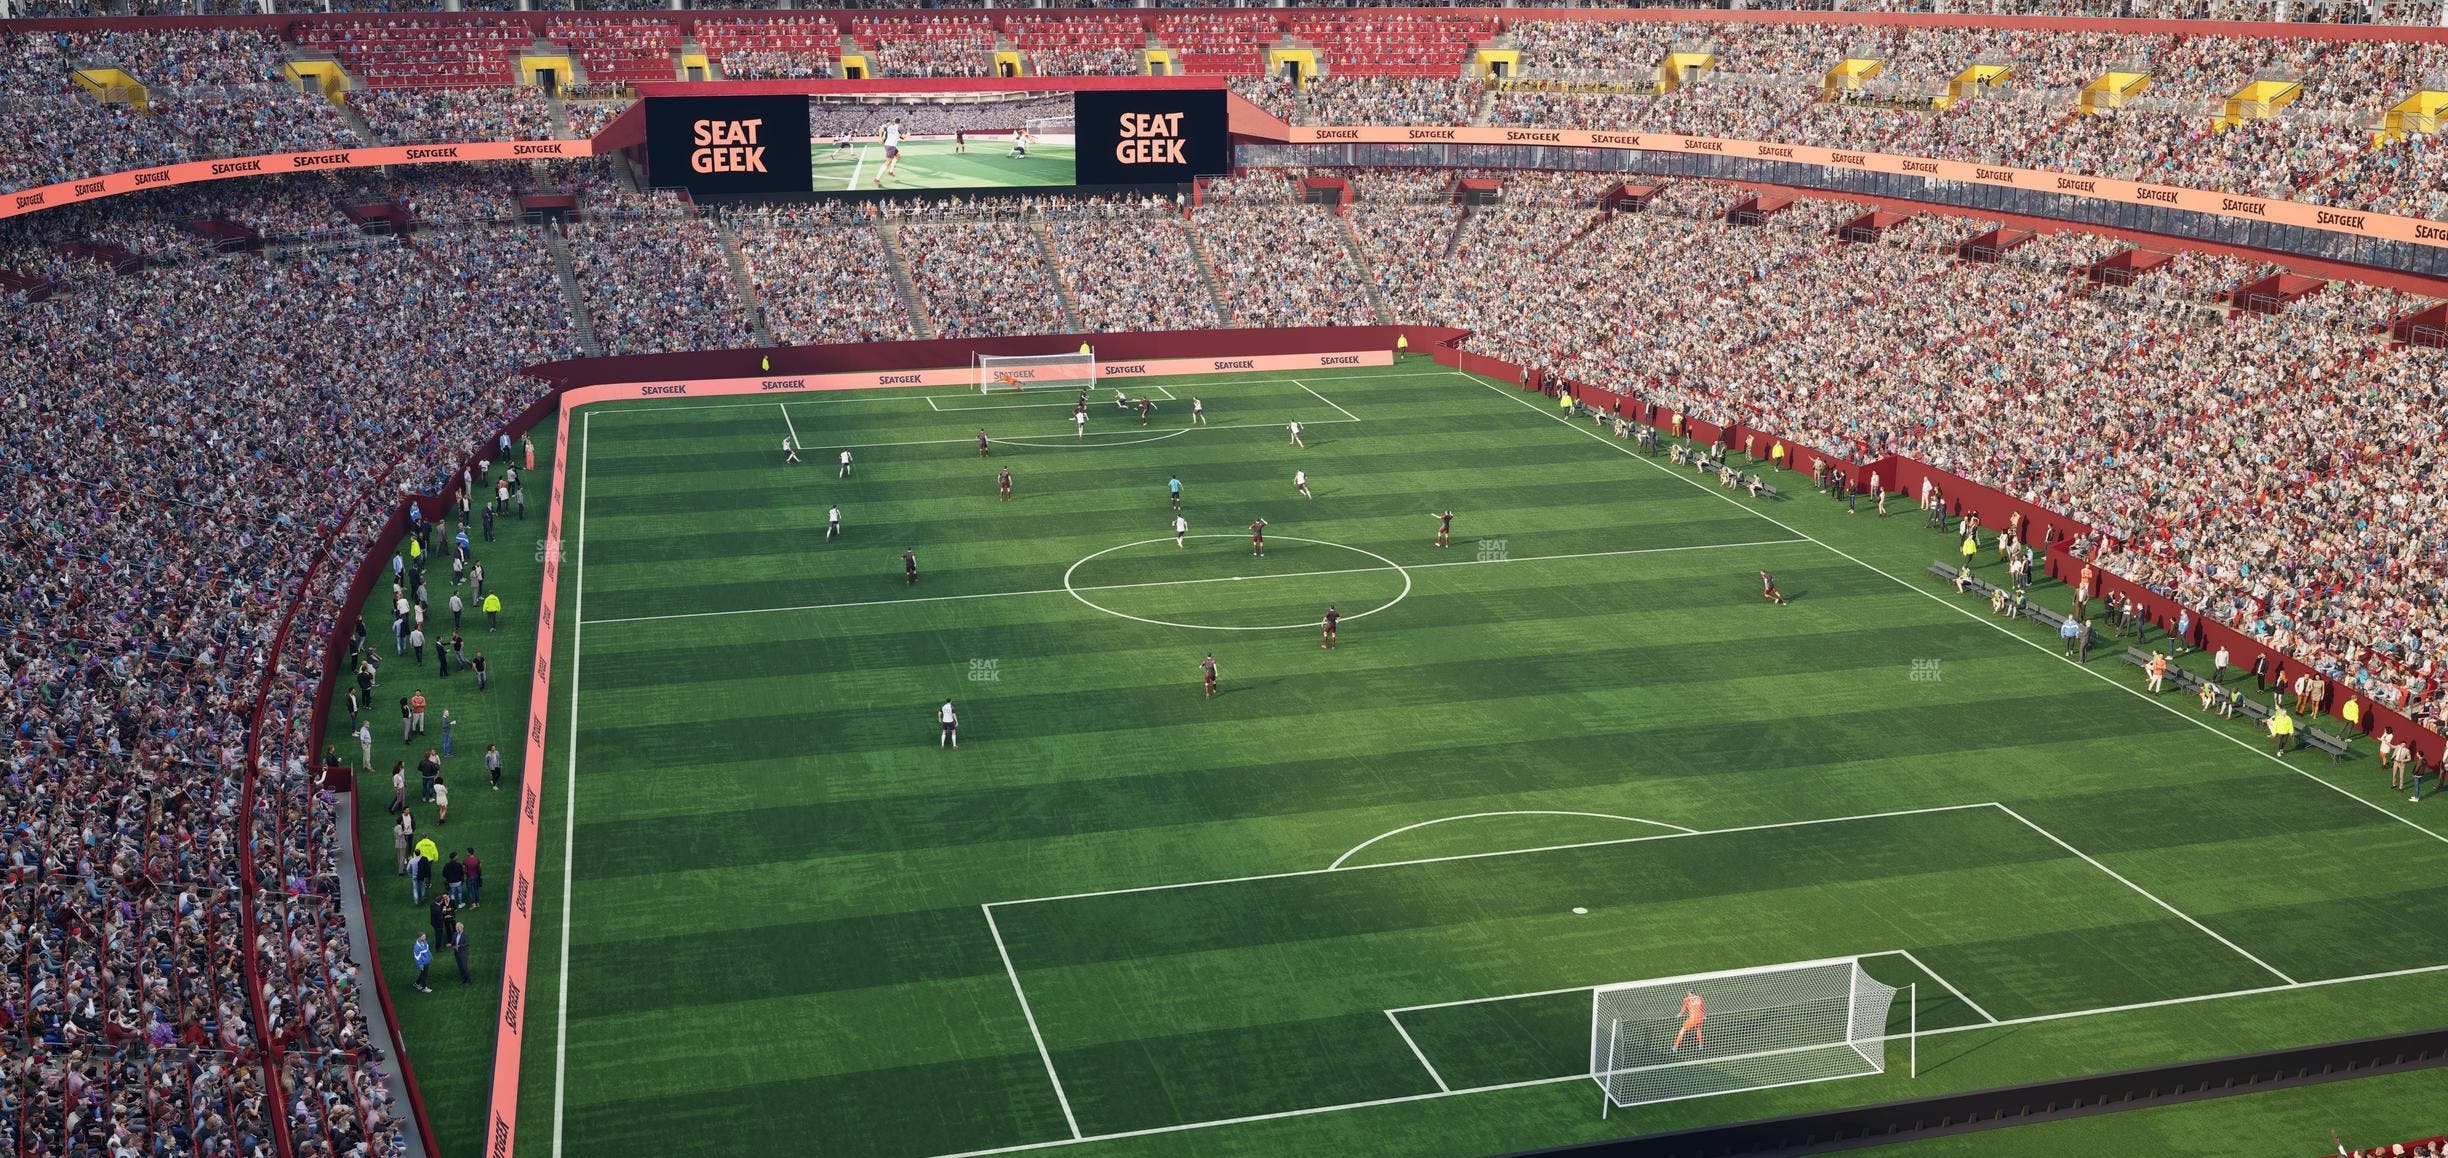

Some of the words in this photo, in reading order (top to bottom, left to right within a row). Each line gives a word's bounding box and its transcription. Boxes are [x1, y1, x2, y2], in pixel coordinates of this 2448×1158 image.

[1120, 112, 1184, 137] SEAT
[694, 119, 762, 146] SEAT
[1316, 129, 1358, 140] SEATGEEK
[1409, 129, 1454, 140] SEATGEEK
[1507, 131, 1560, 142] SEATGEEK
[1591, 134, 1640, 145] SEATGEEK
[513, 143, 562, 155] SEATGEEK
[1116, 139, 1186, 164] GEEK
[1684, 139, 1723, 151] SEATGEEK
[1758, 145, 1793, 158] SEATGEEK
[407, 147, 458, 159] SEATGEEK
[1831, 152, 1866, 166] SEATGEEK
[212, 160, 261, 175] SEATGEEK
[293, 153, 350, 168] SEATGEEK
[692, 148, 767, 173] GEEK
[1902, 160, 1938, 174] SEATGEEK
[135, 170, 170, 186] SEATGEEK
[1976, 168, 2013, 183] SEATGEEK
[2057, 177, 2095, 193] SEATGEEK
[2137, 187, 2178, 204] SEATGEEK
[2222, 198, 2266, 216] SEATGEEK
[2317, 211, 2364, 229] SEATGEEK
[2415, 224, 2448, 241] SEATG
[1214, 359, 1254, 370] SEATGEEK
[1321, 355, 1360, 366] SEATGEEK
[1105, 364, 1146, 375] SEATGEEK
[762, 379, 805, 390] SEATGEEK
[879, 374, 921, 385] SEATGEEK
[641, 385, 686, 396] SEATGEEK
[505, 975, 520, 1035] SEATGEEK
